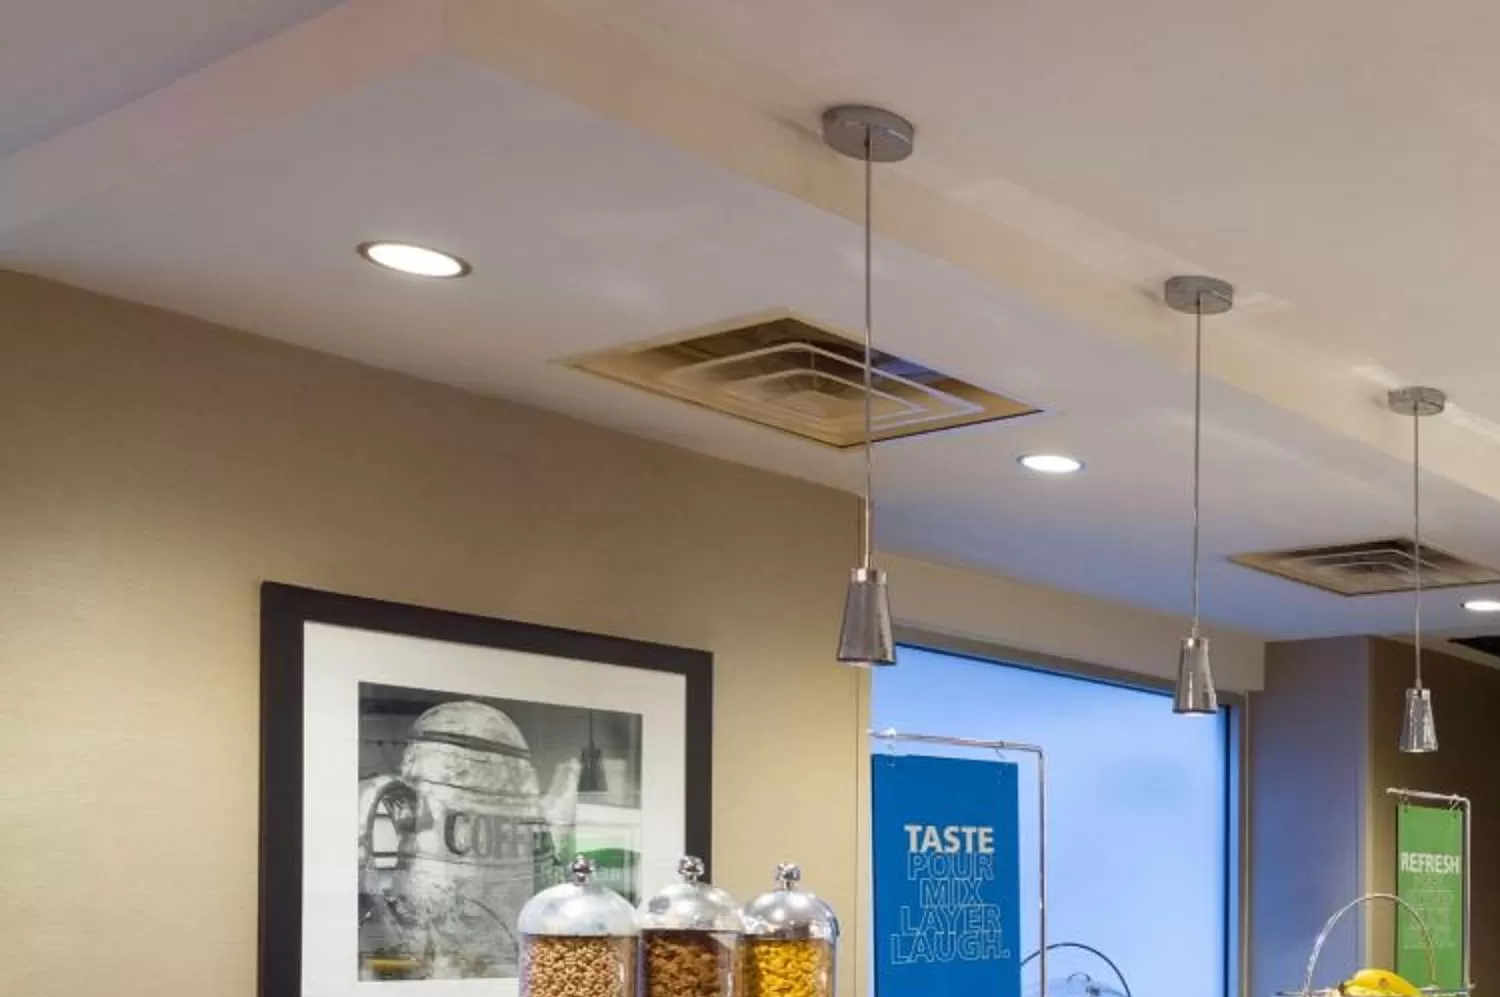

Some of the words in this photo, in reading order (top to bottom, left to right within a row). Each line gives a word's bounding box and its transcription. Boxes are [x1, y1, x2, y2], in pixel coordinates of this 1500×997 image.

[904, 824, 995, 854] TASTE
[908, 852, 994, 881] POUR
[1400, 852, 1461, 874] REFRESH
[919, 878, 984, 908] MIX
[900, 904, 1002, 936] LAYER
[891, 931, 1011, 965] LAUGH.
